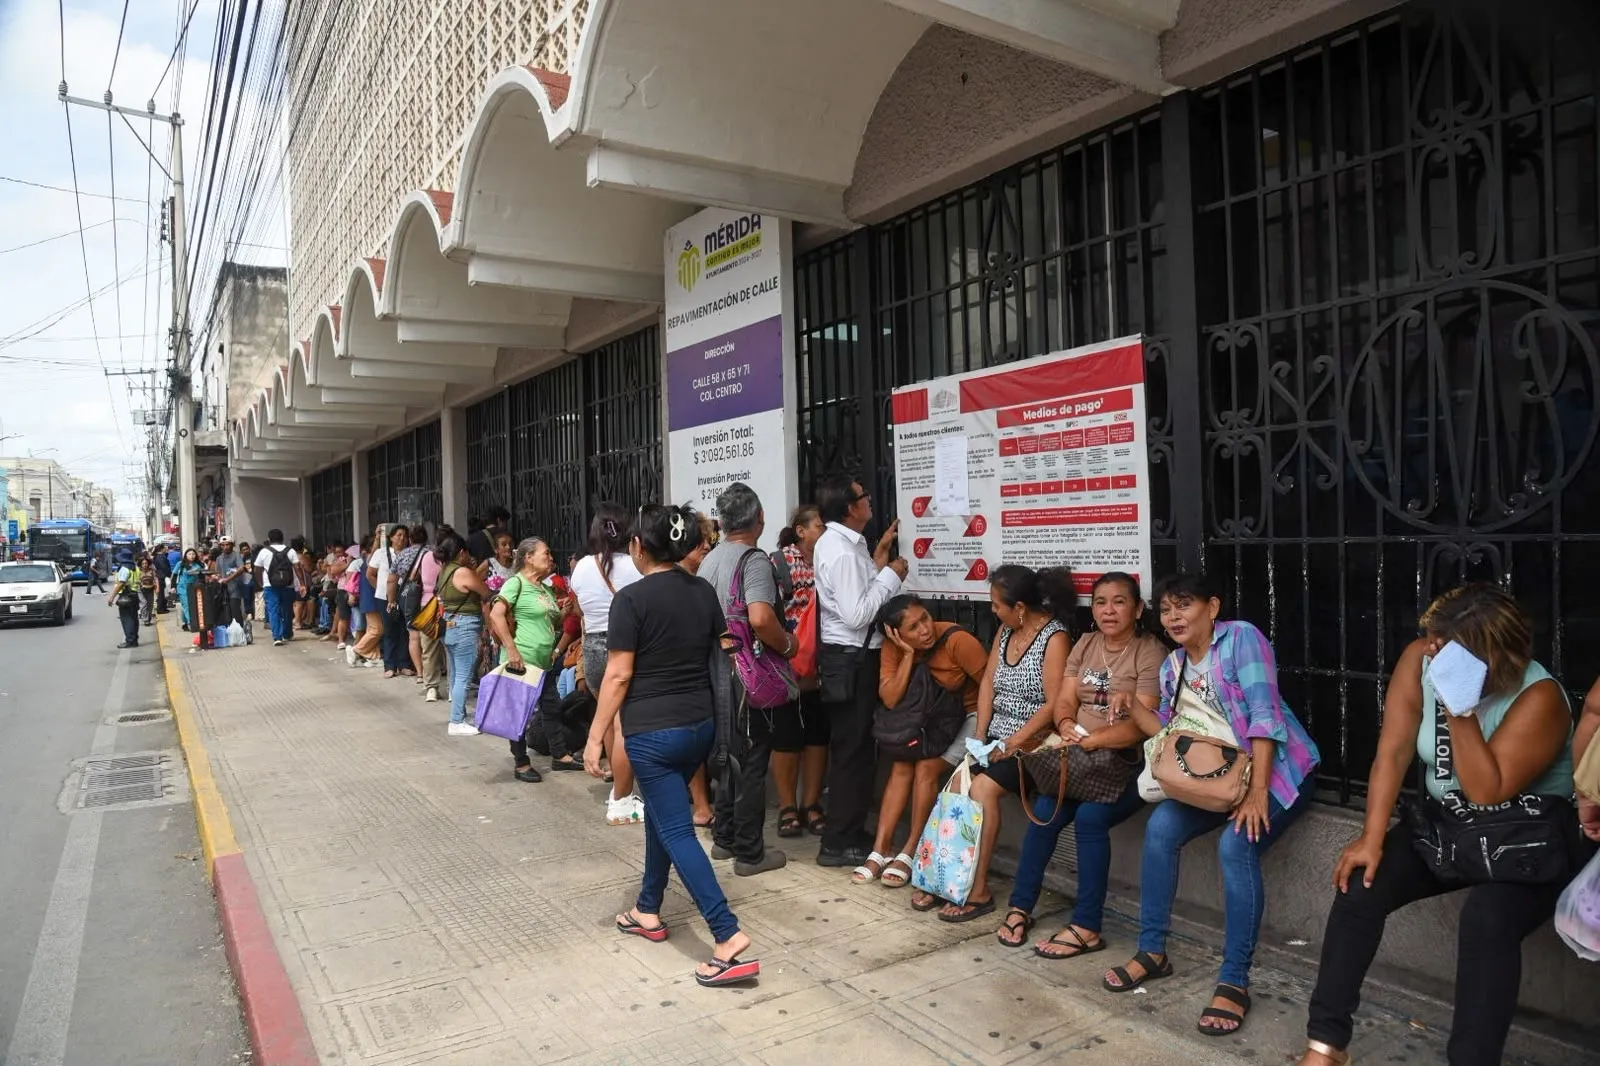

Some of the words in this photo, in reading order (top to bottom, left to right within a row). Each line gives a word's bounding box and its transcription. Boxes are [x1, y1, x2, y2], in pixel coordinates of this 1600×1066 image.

[704, 213, 761, 255] MÉRIDA
[706, 251, 731, 267] CONTIGO
[732, 247, 740, 257] ES
[667, 290, 739, 329] REPAVIMENTACIÓN
[740, 287, 750, 302] DE
[752, 276, 778, 297] CALLE
[704, 341, 735, 359] DIRECCIÓN
[692, 374, 710, 389] CALLE
[711, 372, 720, 384] 58
[721, 371, 726, 382] X
[727, 367, 736, 380] 65
[737, 365, 742, 377] Y
[743, 363, 750, 376] 71
[700, 389, 715, 402] COL.
[715, 382, 743, 399] CENTRO
[1023, 405, 1057, 421] Medios
[1060, 403, 1073, 416] de
[693, 429, 729, 447] Inversión
[730, 424, 754, 441] Total:
[918, 428, 940, 438] nuestros
[693, 451, 699, 465] $
[697, 473, 726, 486] Inversión
[726, 469, 752, 483] Parcial:
[1437, 722, 1450, 731] Y
[1436, 735, 1450, 778] LOLA
